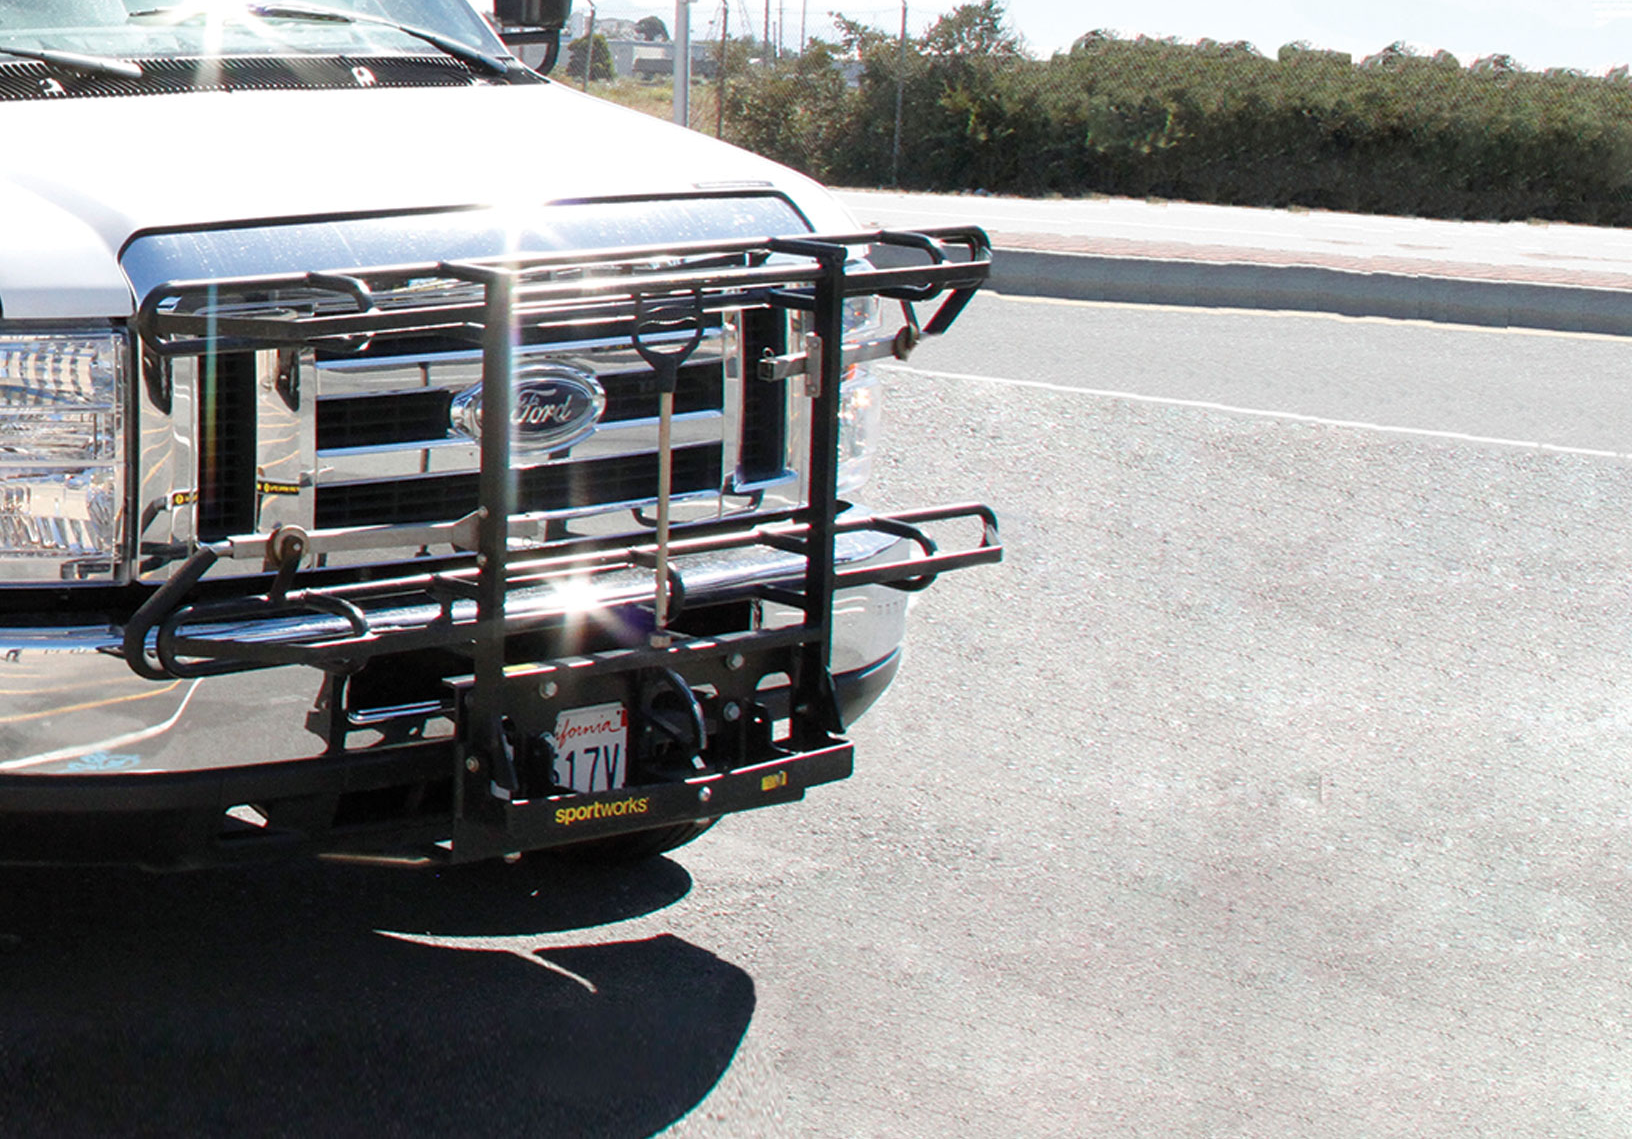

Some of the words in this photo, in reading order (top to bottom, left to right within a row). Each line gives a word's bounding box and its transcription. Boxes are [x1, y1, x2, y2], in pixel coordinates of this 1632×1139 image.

[511, 389, 572, 424] Ford
[555, 718, 621, 750] ifornia
[555, 798, 648, 825] sportworks
